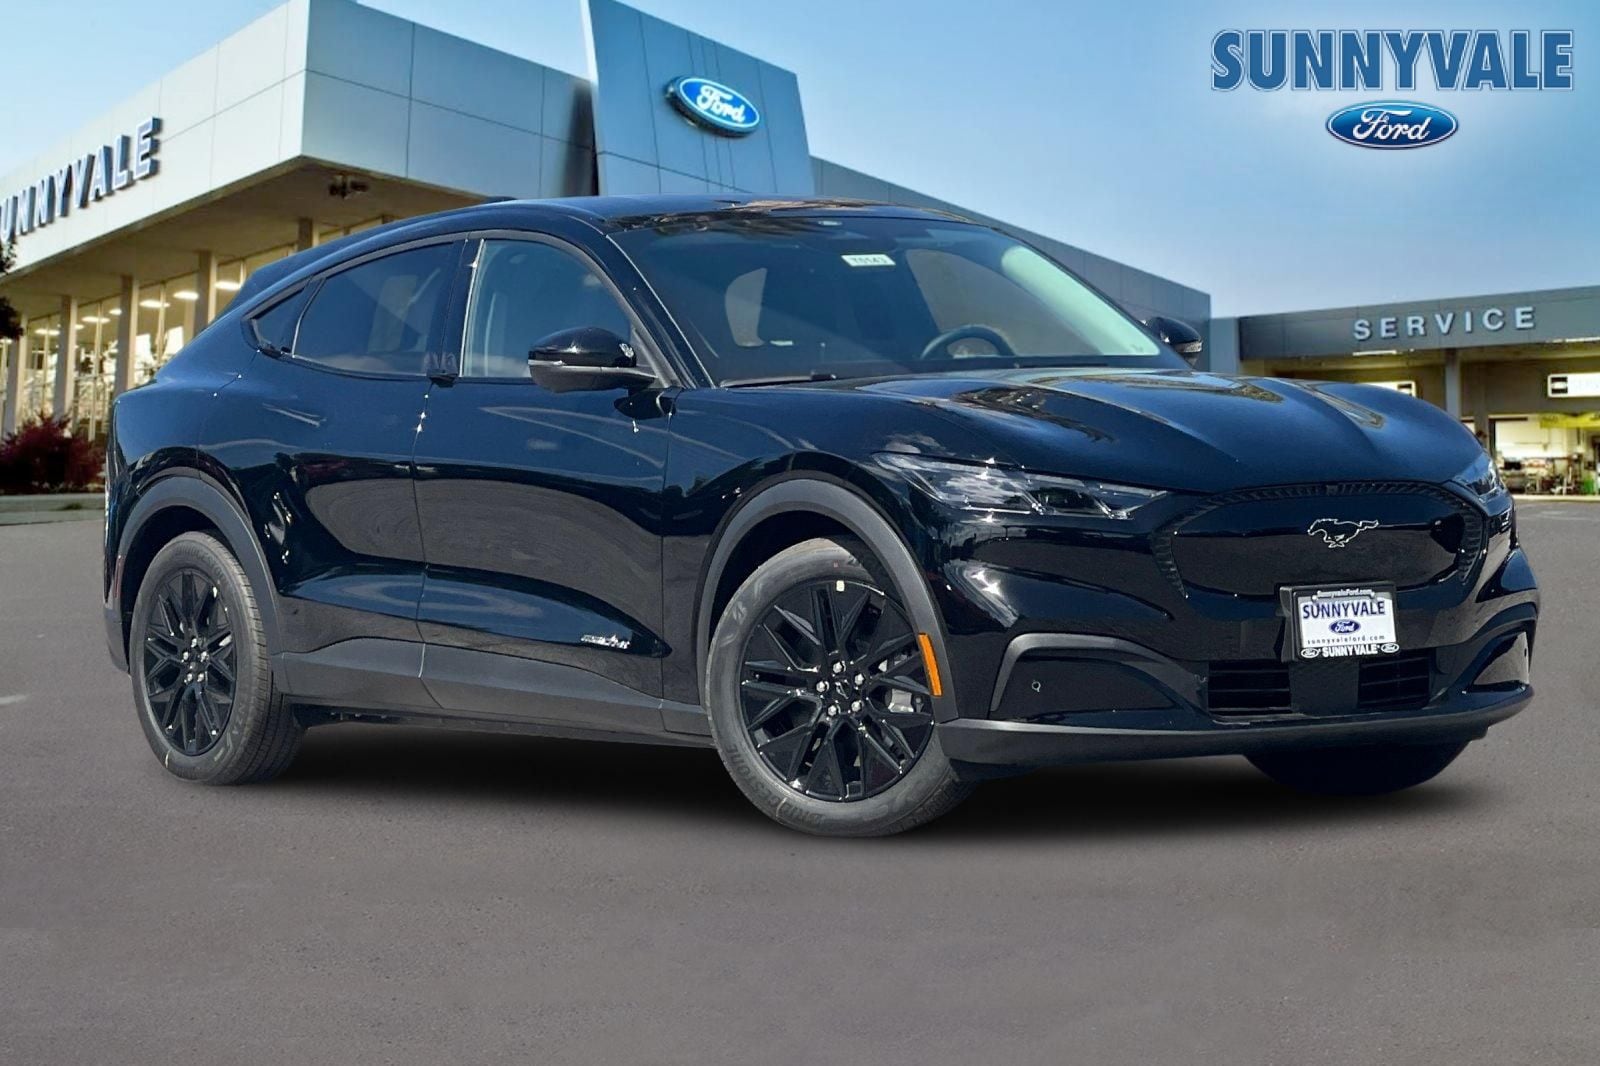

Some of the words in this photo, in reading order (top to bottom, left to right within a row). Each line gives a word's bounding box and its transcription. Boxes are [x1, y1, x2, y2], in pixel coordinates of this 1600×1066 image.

[696, 85, 746, 122] Ford
[1353, 306, 1535, 340] SERVICE
[1303, 600, 1385, 619] SUNNYVALE
[1334, 620, 1356, 633] Ford
[1307, 635, 1385, 645] sunnyvaleford.com
[1322, 644, 1378, 657] SUNNYVALE
